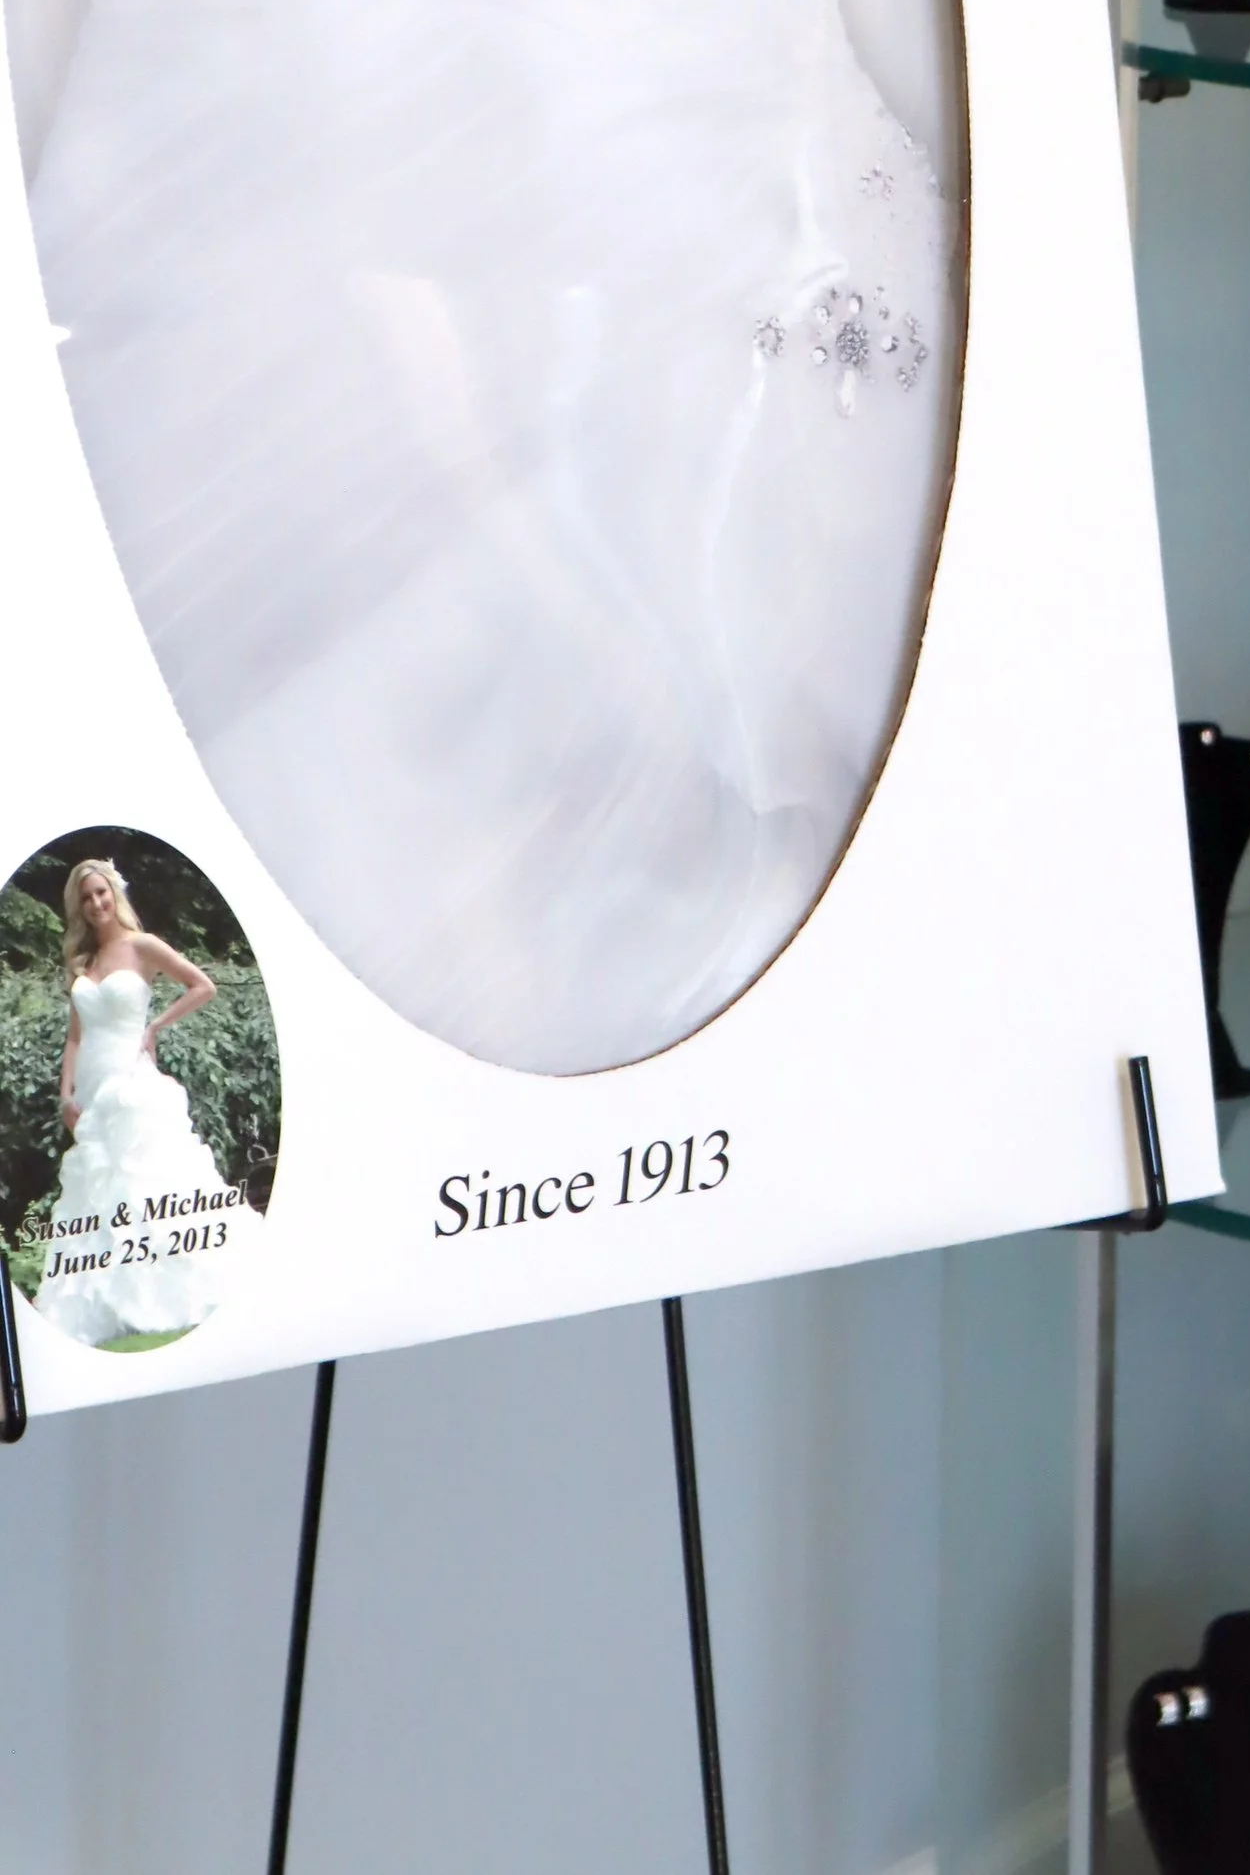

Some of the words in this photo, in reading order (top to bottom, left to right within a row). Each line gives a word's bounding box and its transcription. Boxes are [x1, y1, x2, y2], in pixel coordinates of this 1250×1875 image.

[20, 1212, 101, 1245] Susan
[110, 1201, 132, 1228] &
[141, 1179, 249, 1224] Michael
[434, 1169, 595, 1239] Since
[613, 1129, 731, 1207] 1913
[47, 1250, 112, 1279] June
[120, 1235, 158, 1265] 25,
[167, 1222, 228, 1257] 2013
